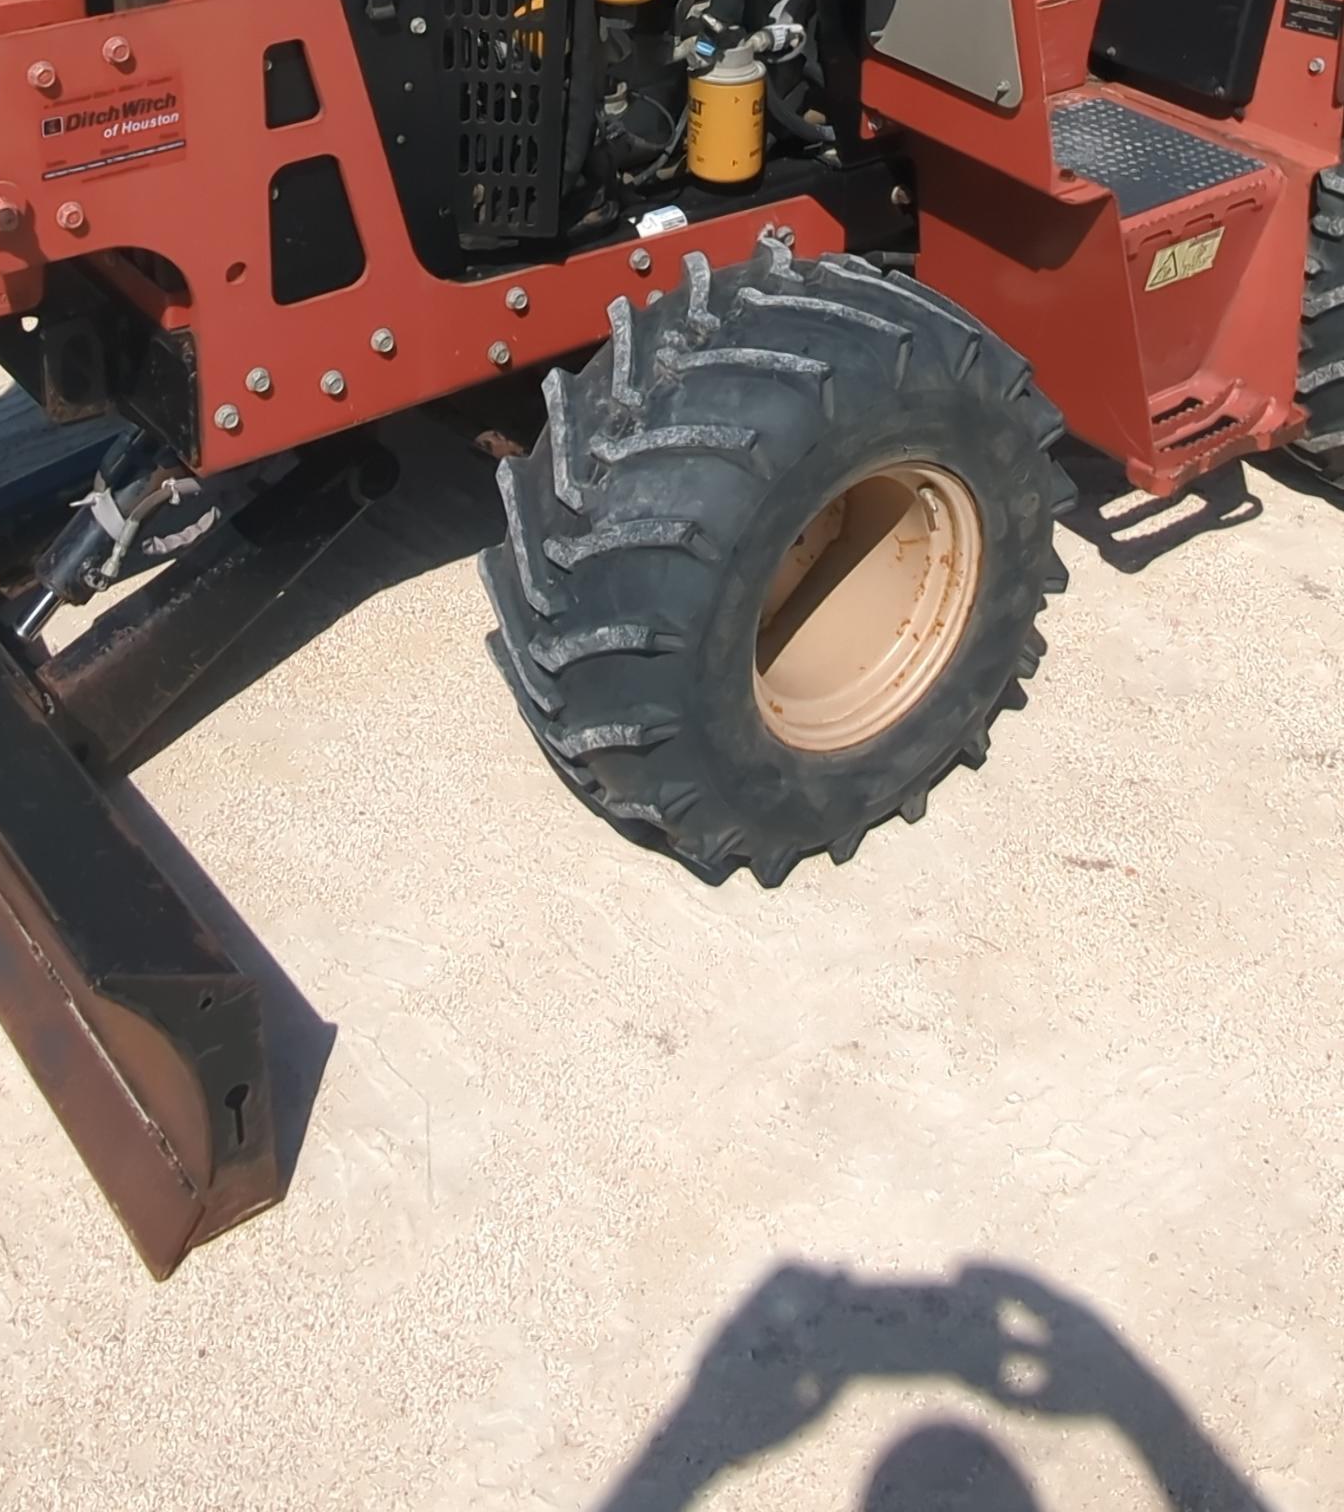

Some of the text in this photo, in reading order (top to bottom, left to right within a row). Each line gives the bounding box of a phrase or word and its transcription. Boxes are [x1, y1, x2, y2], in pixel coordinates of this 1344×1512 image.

[65, 106, 121, 132] Ditch
[122, 92, 177, 118] Witch
[103, 112, 180, 139] of Houston
